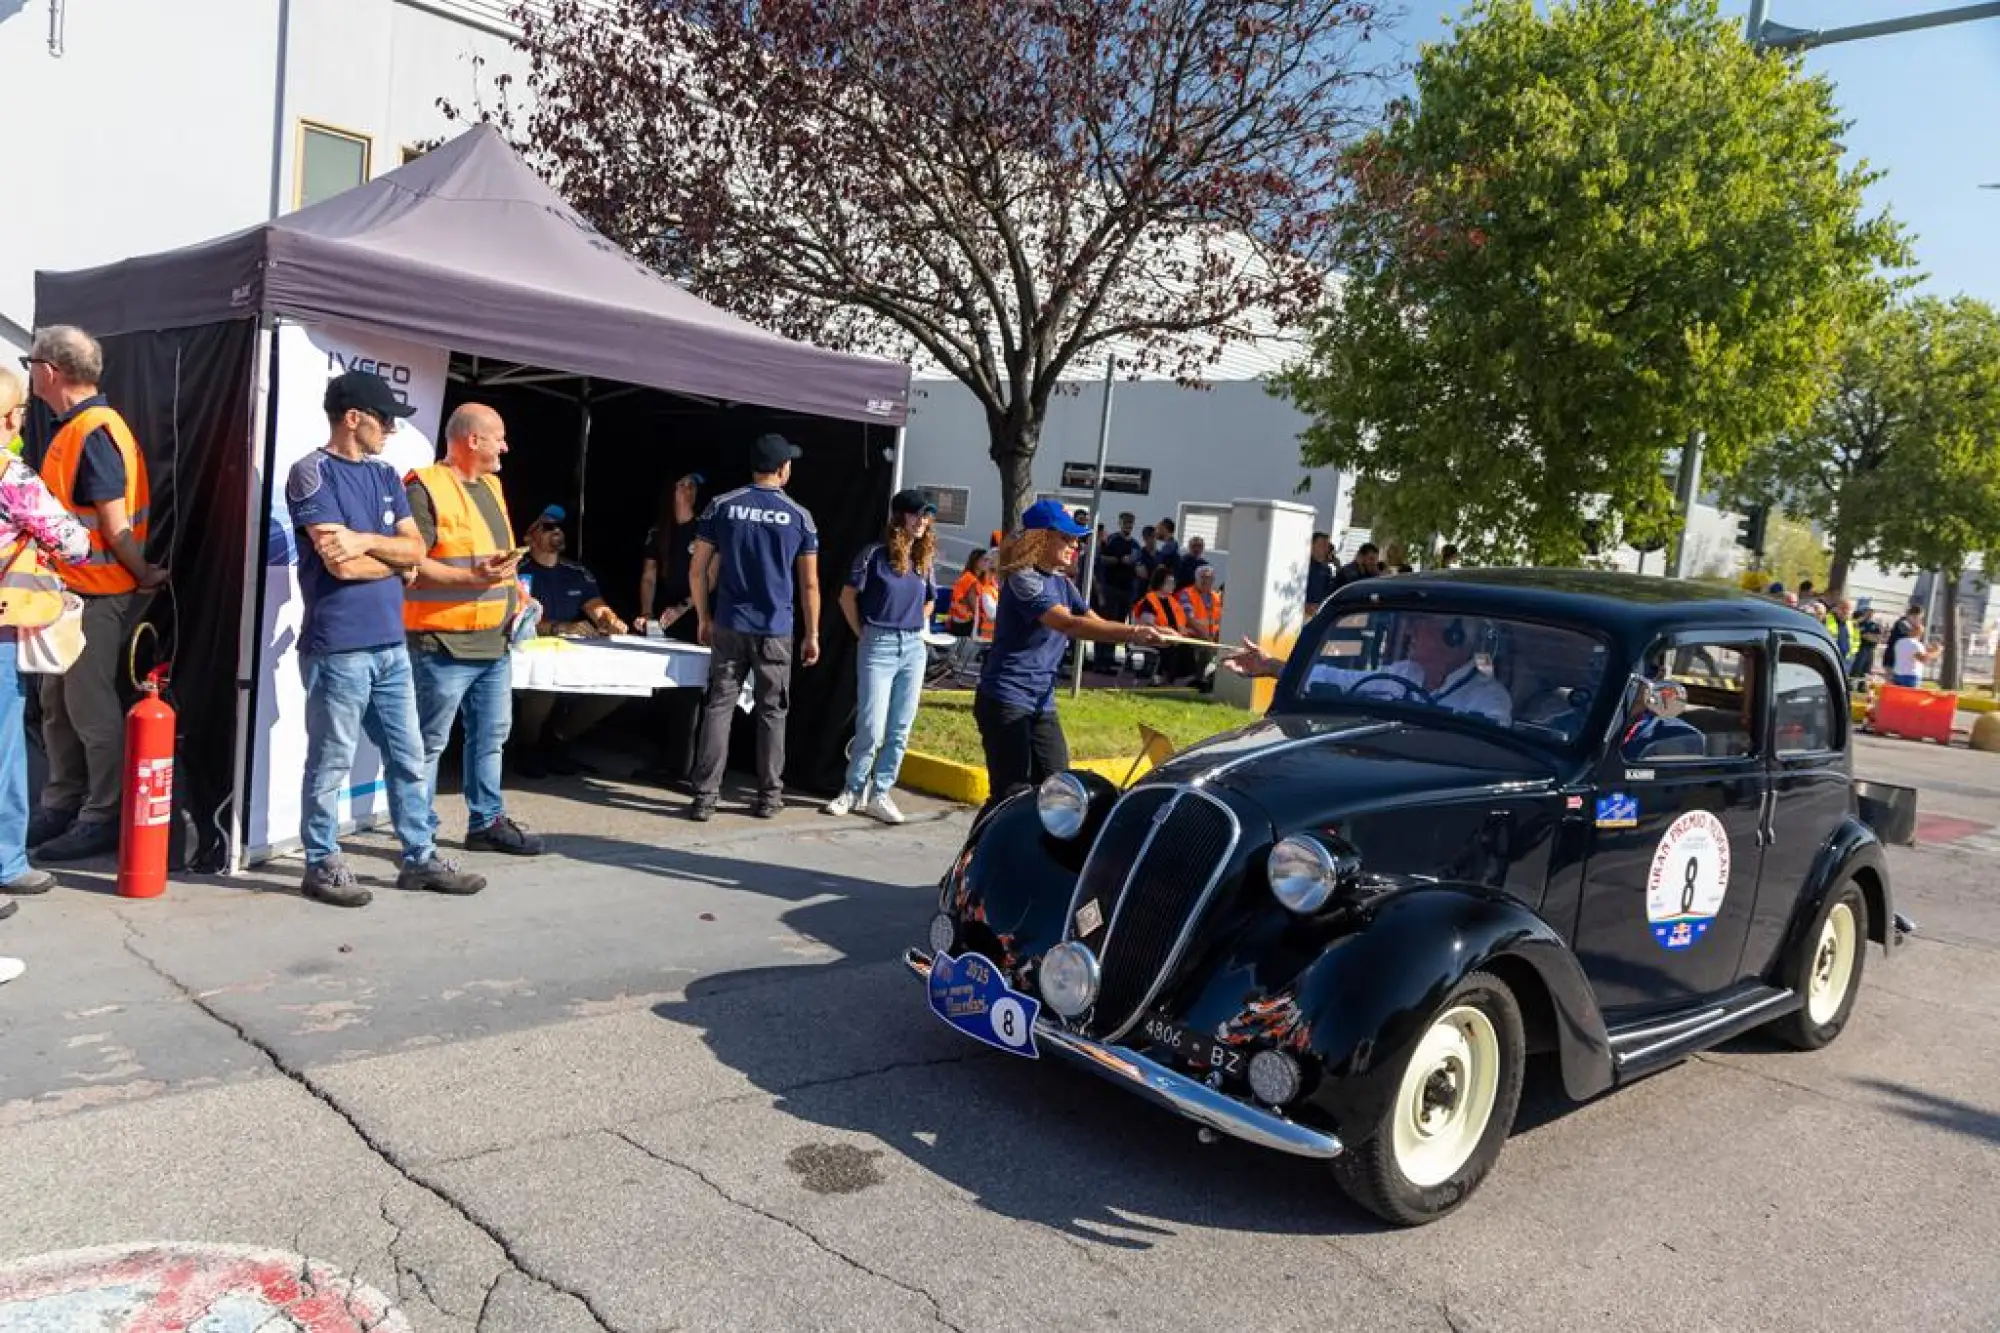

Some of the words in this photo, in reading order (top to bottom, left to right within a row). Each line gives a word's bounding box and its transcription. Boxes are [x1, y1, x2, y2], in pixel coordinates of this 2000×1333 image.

[728, 505, 791, 525] IVECO
[1680, 856, 1698, 914] 8
[1003, 1008, 1015, 1037] 8
[1145, 1018, 1183, 1047] 4806
[1210, 1045, 1240, 1074] BZ
